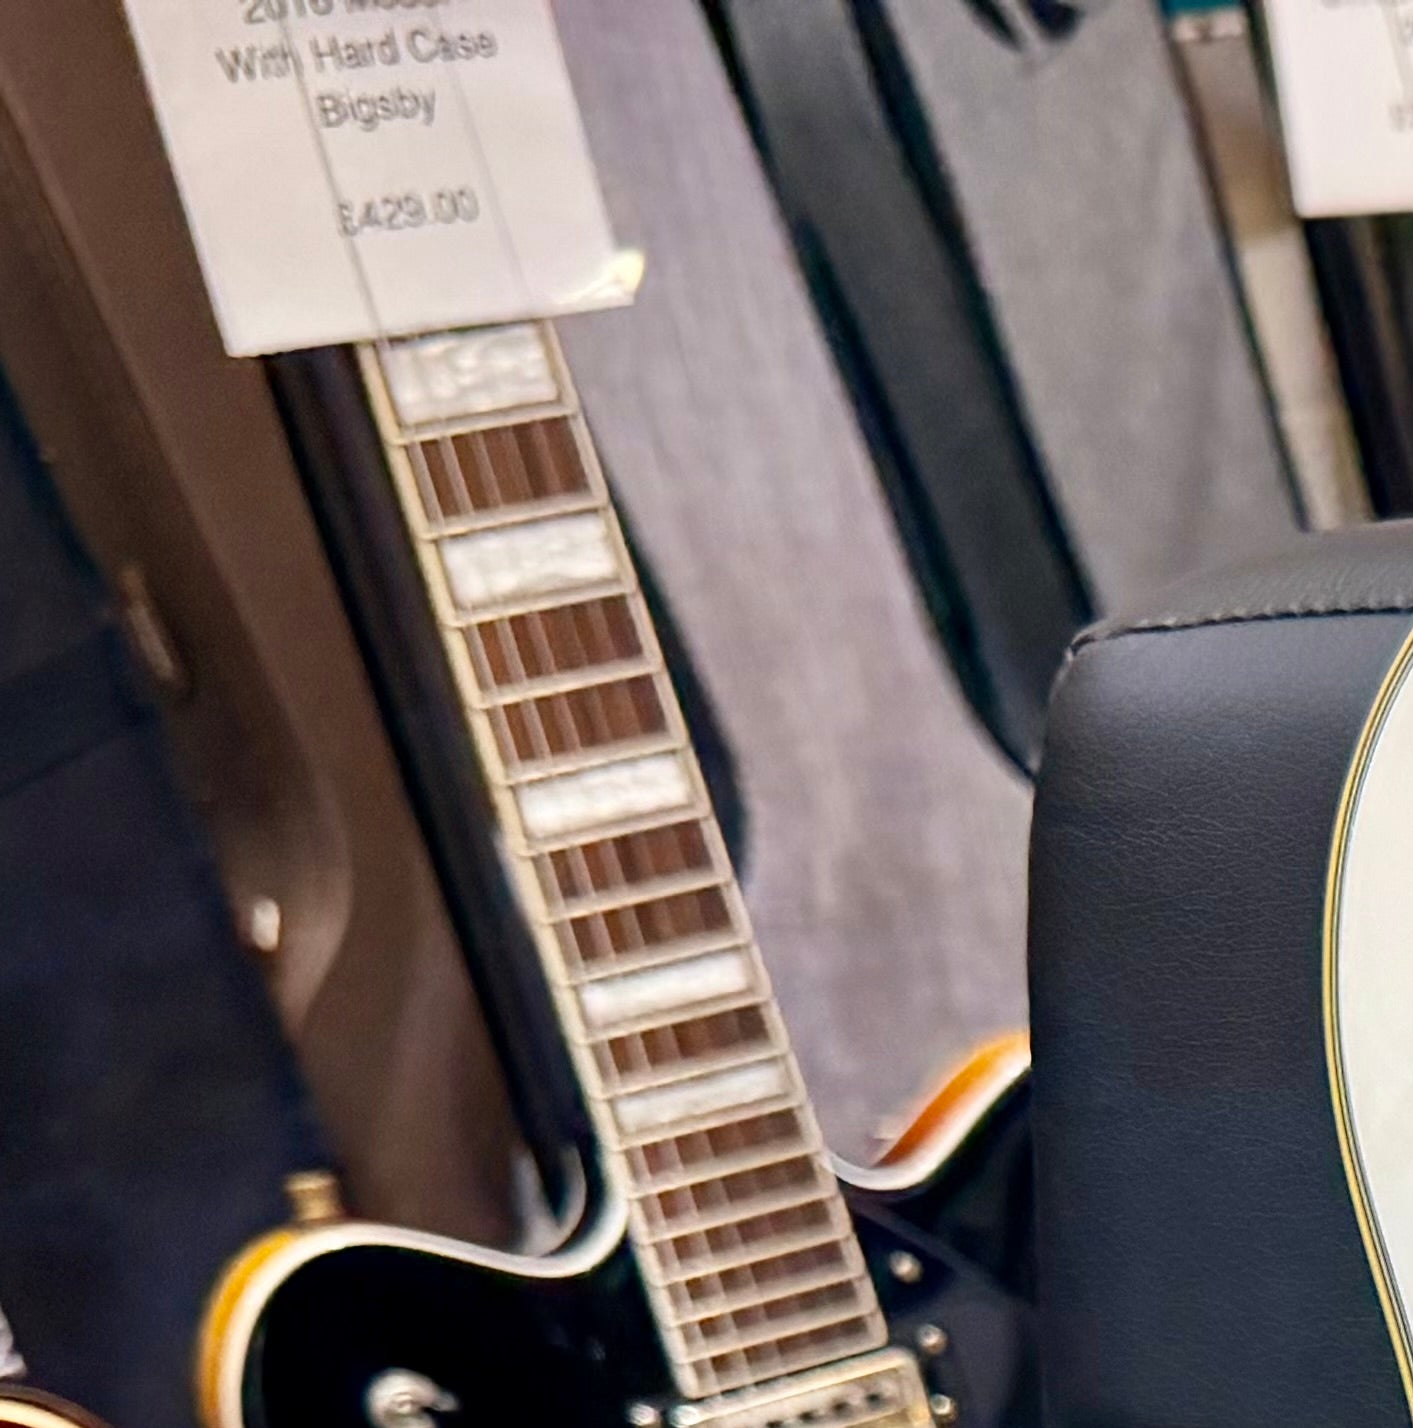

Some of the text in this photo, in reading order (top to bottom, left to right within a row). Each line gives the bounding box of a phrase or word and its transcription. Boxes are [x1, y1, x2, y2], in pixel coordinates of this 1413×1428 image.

[214, 27, 498, 83] With Hard Case
[318, 88, 437, 129] Bigsby
